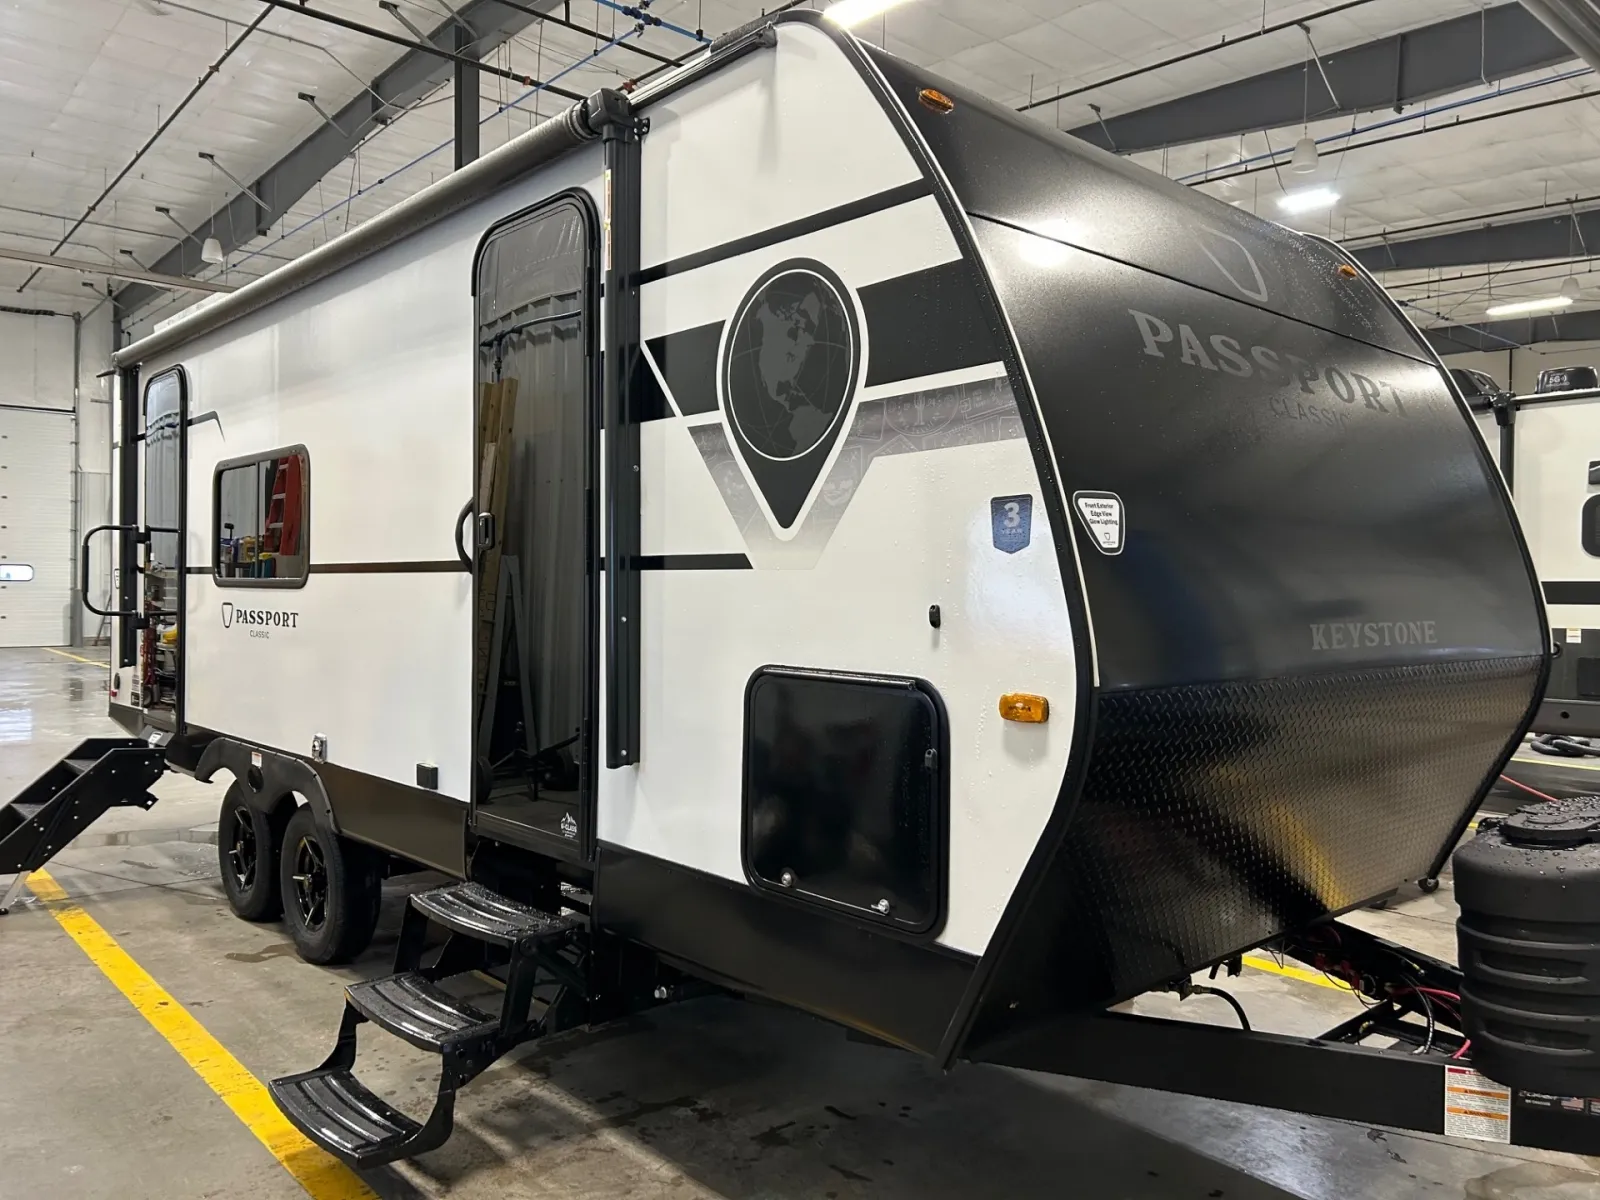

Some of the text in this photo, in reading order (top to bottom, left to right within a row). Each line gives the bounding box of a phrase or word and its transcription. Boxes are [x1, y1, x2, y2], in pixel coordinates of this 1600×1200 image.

[1127, 308, 1408, 418] PASSPORT
[1268, 396, 1351, 430] CLASSIC
[1003, 502, 1021, 528] 3
[1090, 510, 1101, 518] Edge
[235, 609, 299, 628] PASSPORT
[249, 629, 270, 639] CLASSIC
[1309, 620, 1438, 650] KEYSTONE
